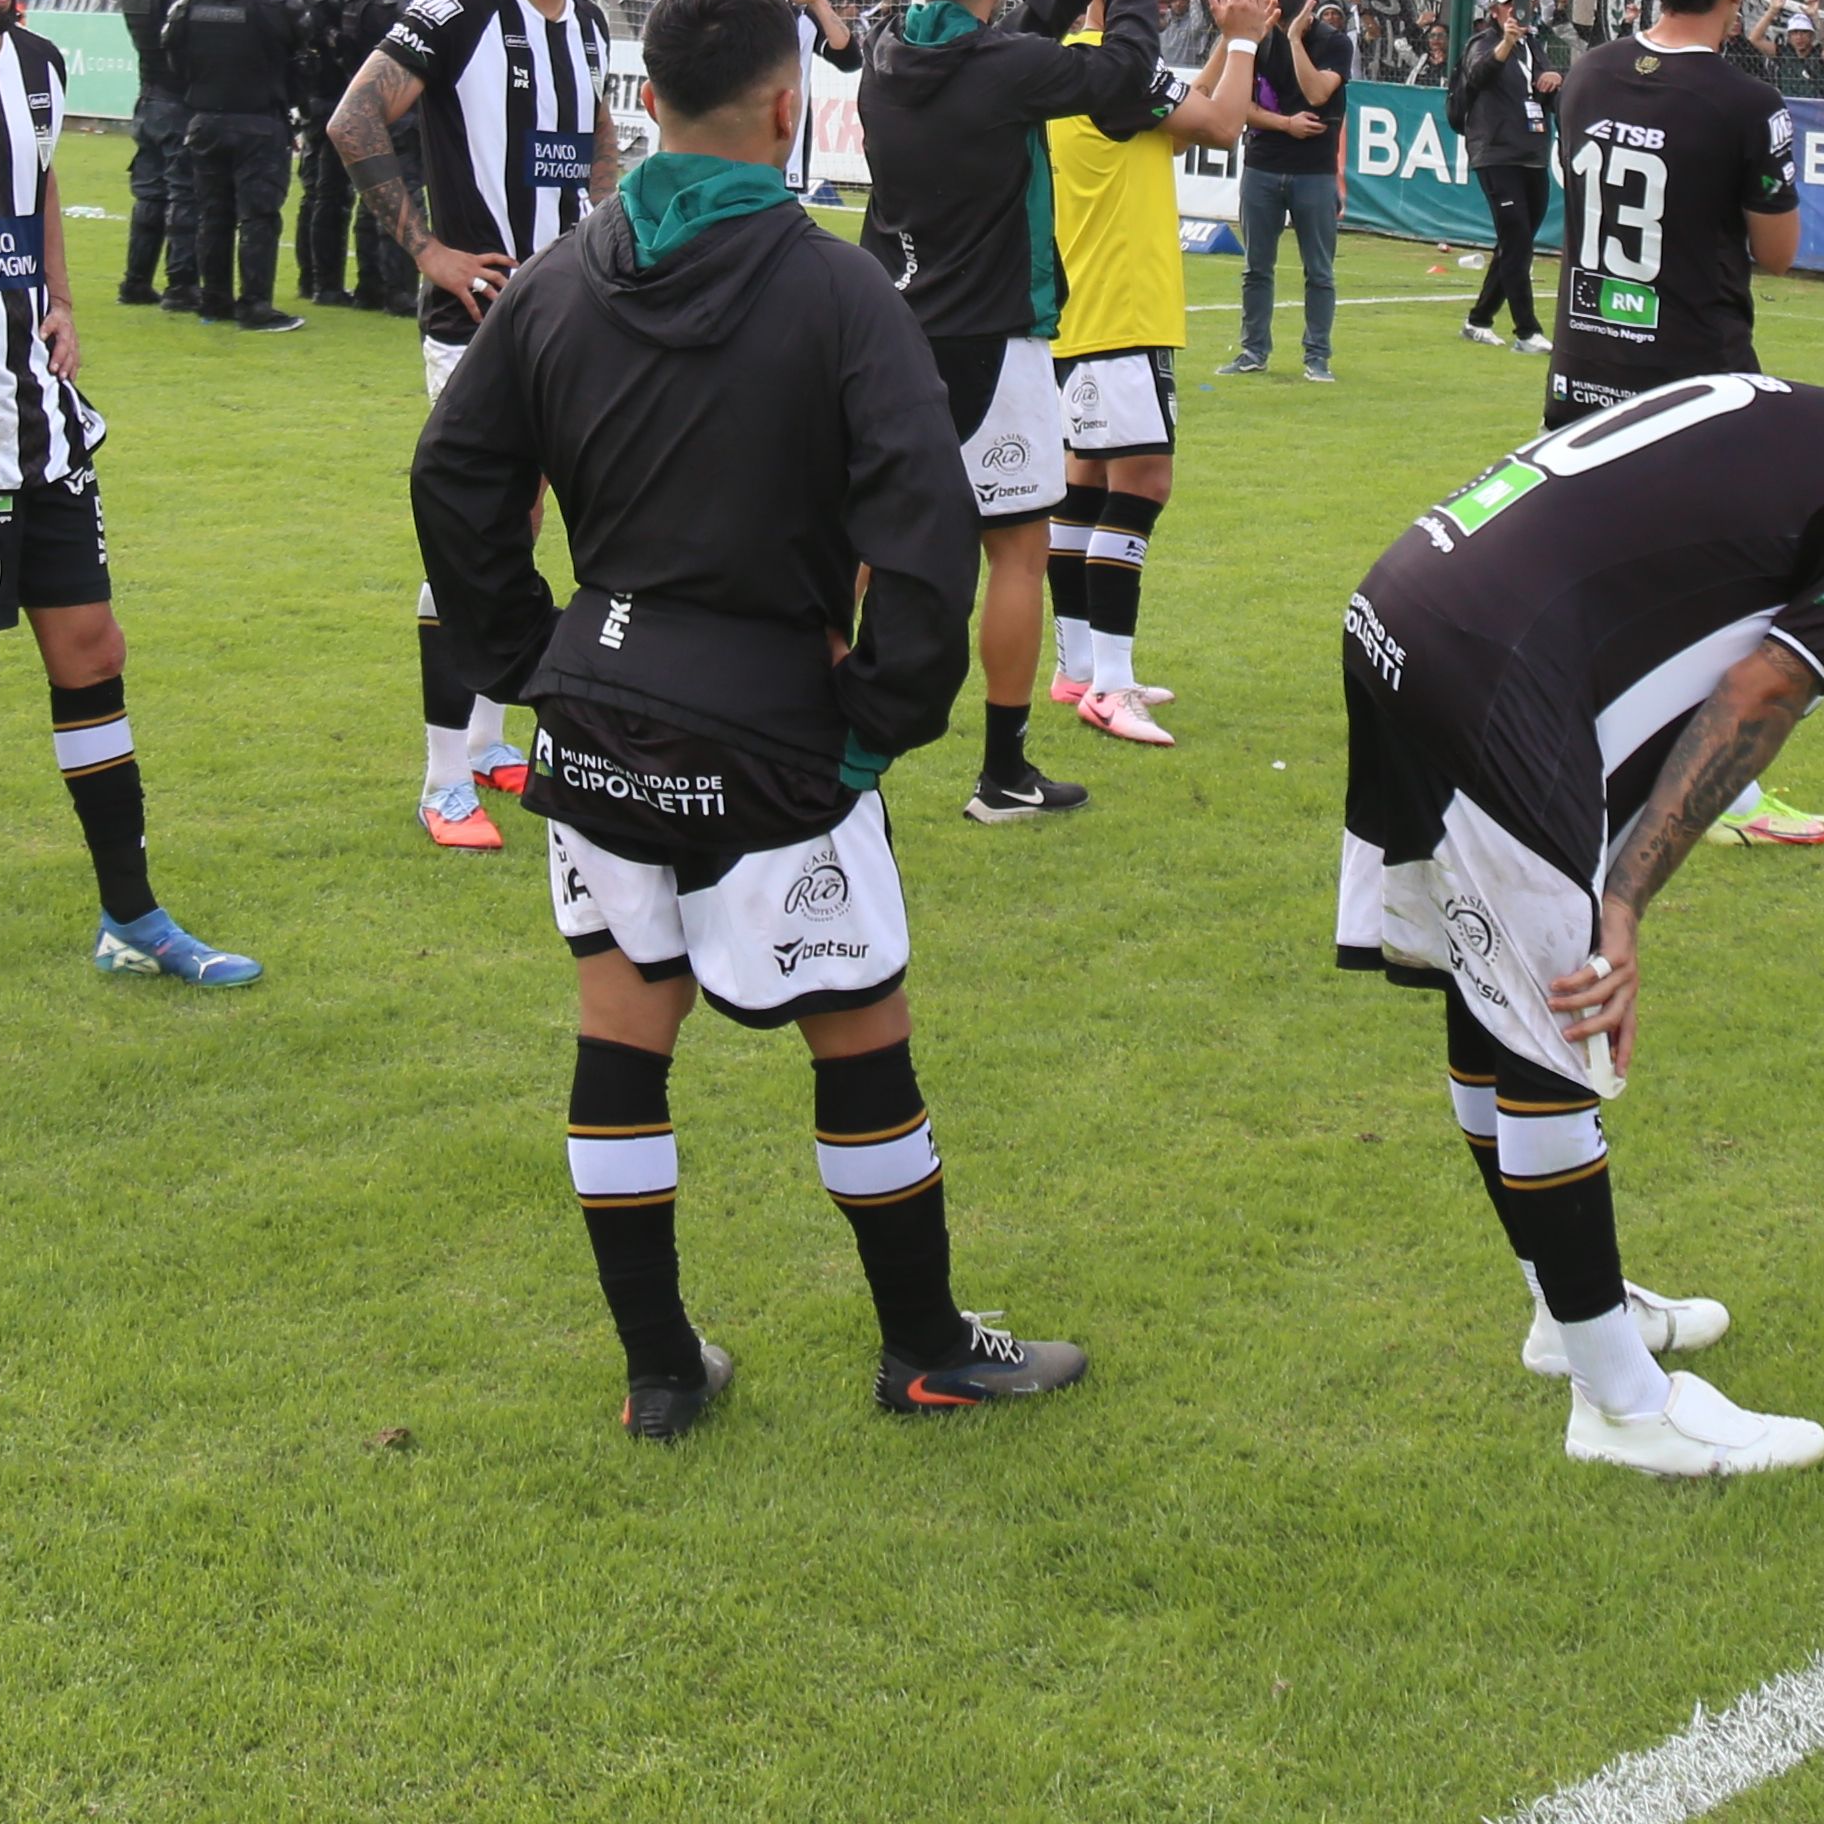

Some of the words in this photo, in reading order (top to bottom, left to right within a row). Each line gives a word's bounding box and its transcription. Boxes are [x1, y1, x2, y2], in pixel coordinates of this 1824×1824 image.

[513, 79, 530, 89] IFK
[534, 142, 577, 160] BANCO
[1572, 140, 1668, 283] 13
[894, 231, 919, 291] SPORTS
[1611, 291, 1644, 313] RN
[997, 482, 1038, 499] betsur
[599, 596, 633, 650] IFK
[1344, 606, 1402, 692] POLLETTI
[563, 765, 725, 816] CIPOLLETTI
[696, 775, 723, 791] DE
[802, 939, 870, 960] betsur
